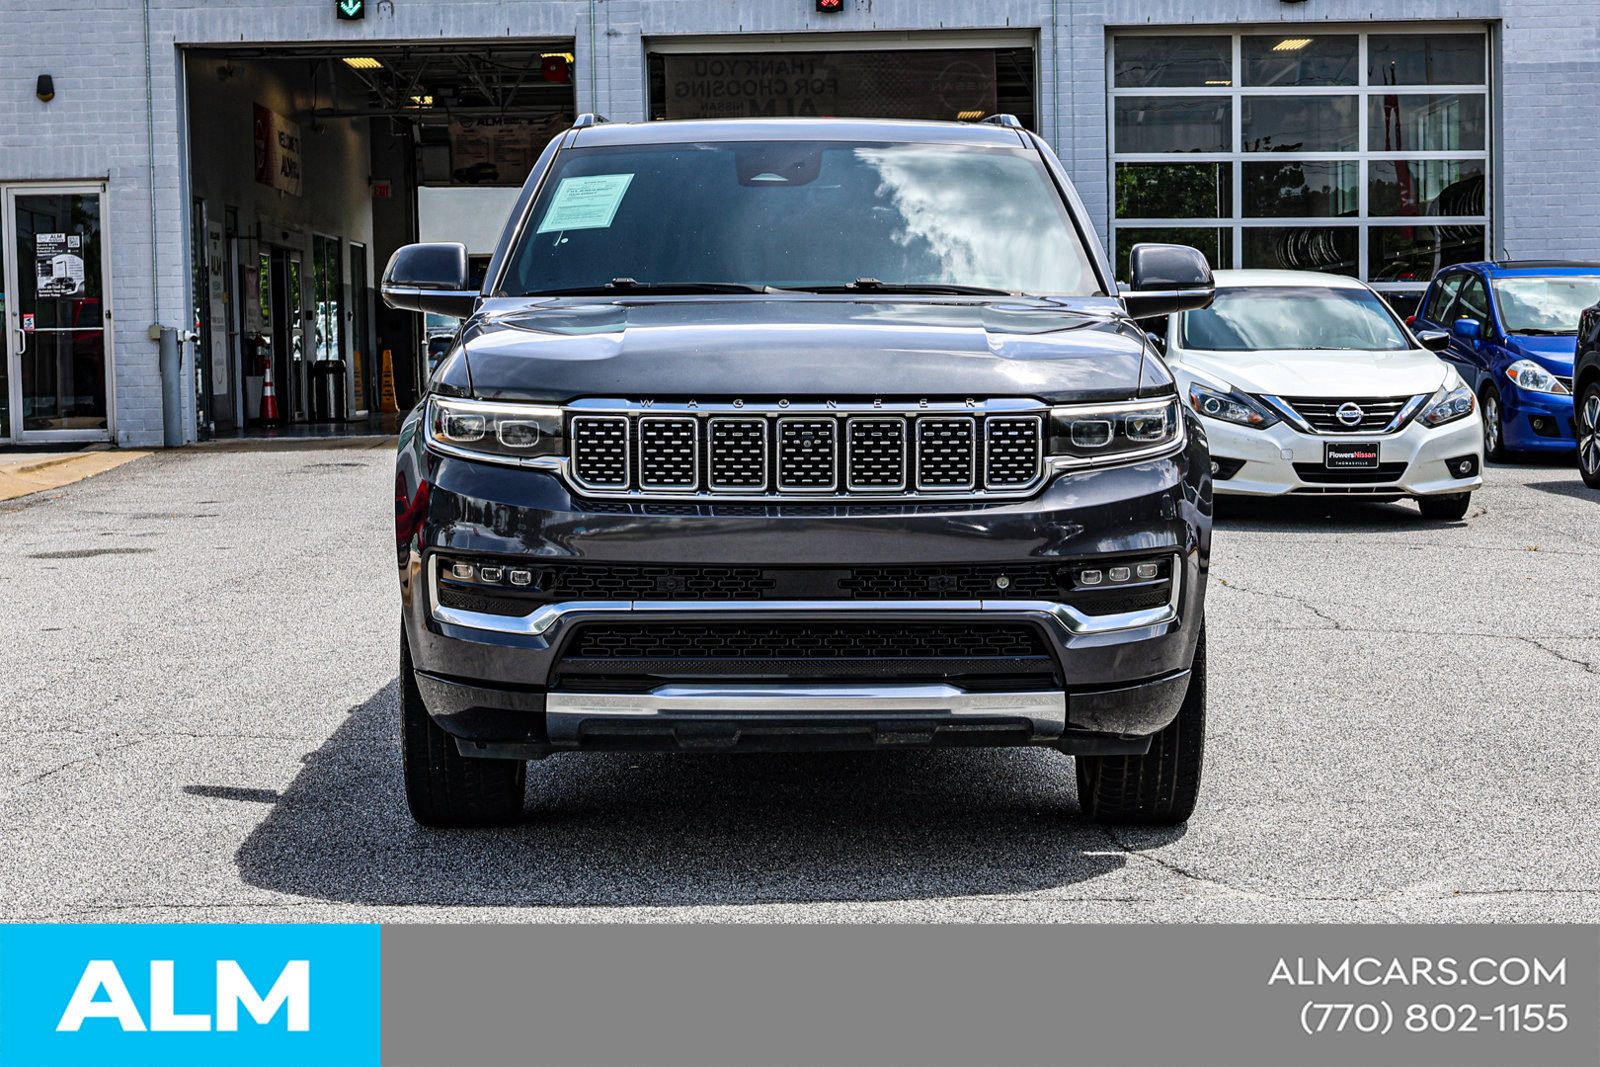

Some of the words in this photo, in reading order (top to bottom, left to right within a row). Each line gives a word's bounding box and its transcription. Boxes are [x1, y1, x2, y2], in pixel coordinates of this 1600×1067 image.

[476, 118, 502, 127] ALM
[374, 184, 389, 197] EXIT
[639, 398, 976, 409] WAGONEER
